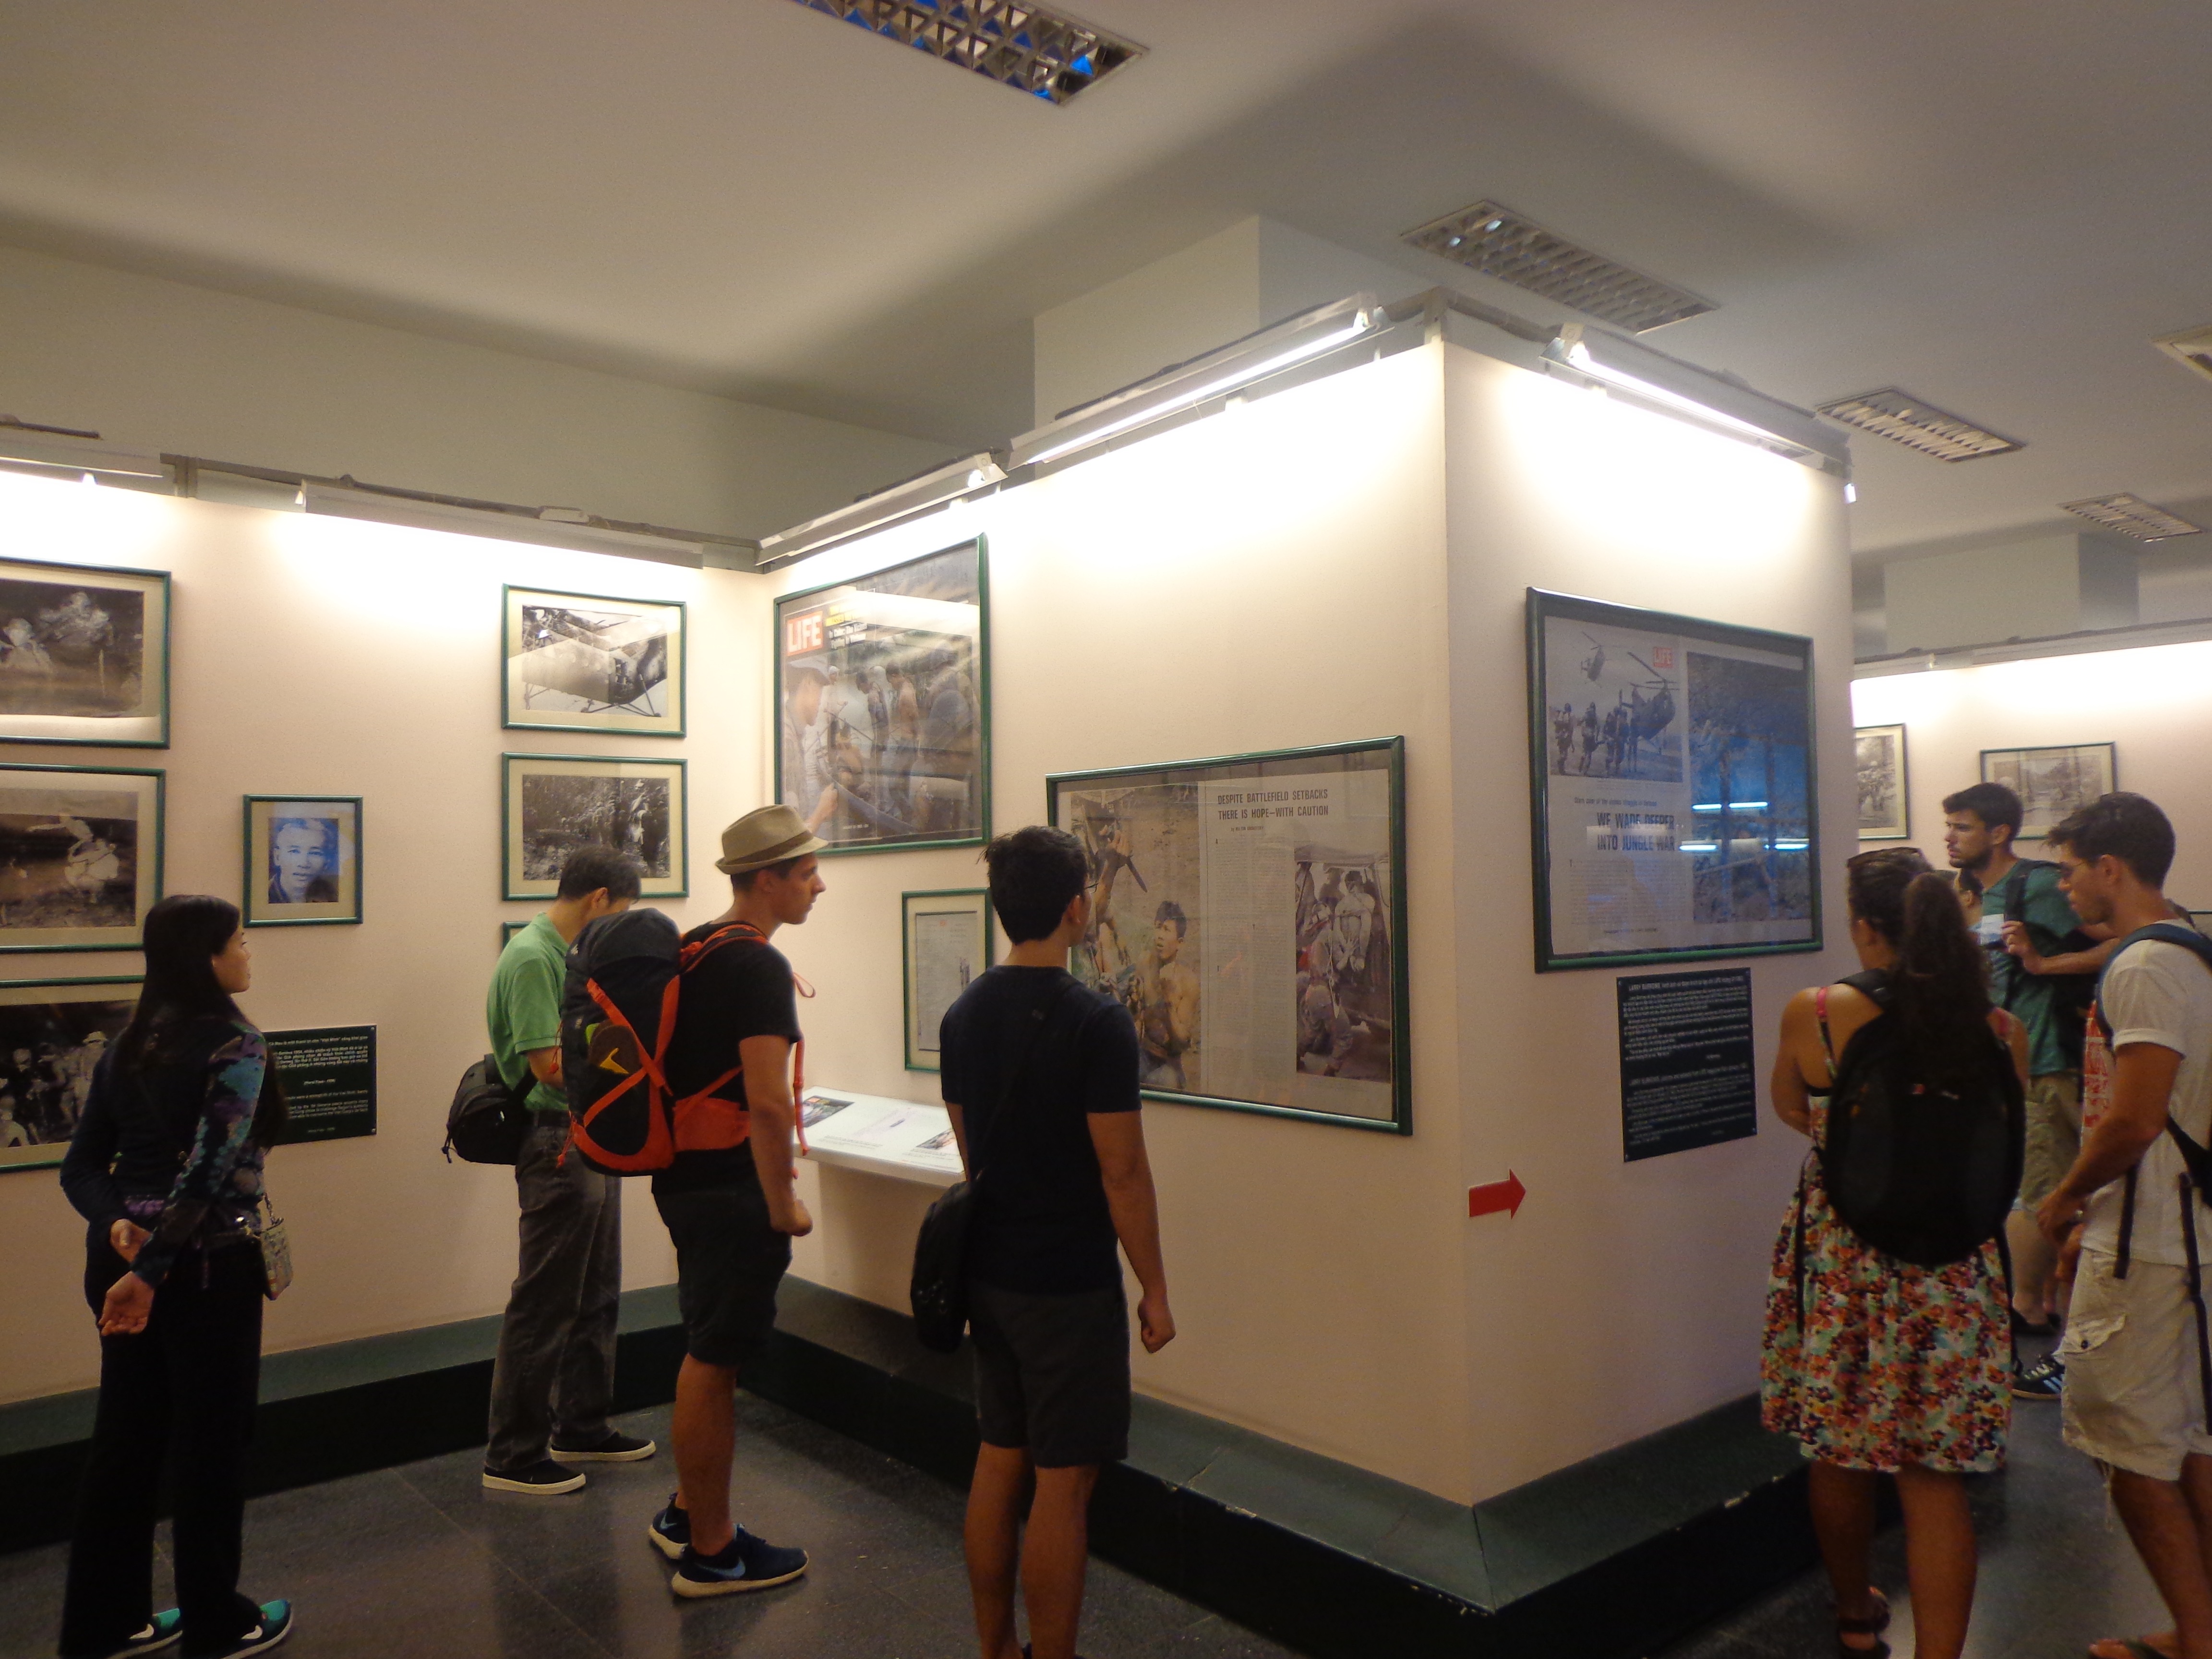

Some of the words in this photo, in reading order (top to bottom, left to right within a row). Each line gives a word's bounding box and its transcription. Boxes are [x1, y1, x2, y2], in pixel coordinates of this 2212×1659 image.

[788, 615, 822, 652] LIFE
[1217, 793, 1243, 805] DESPITE
[1247, 792, 1289, 803] BATTLEFIELD
[1292, 789, 1328, 800] SETBACKS
[1218, 810, 1238, 820] THERE
[1241, 809, 1248, 818] IS
[1297, 805, 1329, 816] CAUTION
[1597, 813, 1611, 827] WE
[1615, 813, 1640, 829] WADE
[1645, 814, 1674, 830] DEEPER
[1597, 834, 1618, 850] INTO
[1622, 835, 1653, 851] JUNGLE
[1656, 835, 1675, 851] WAR
